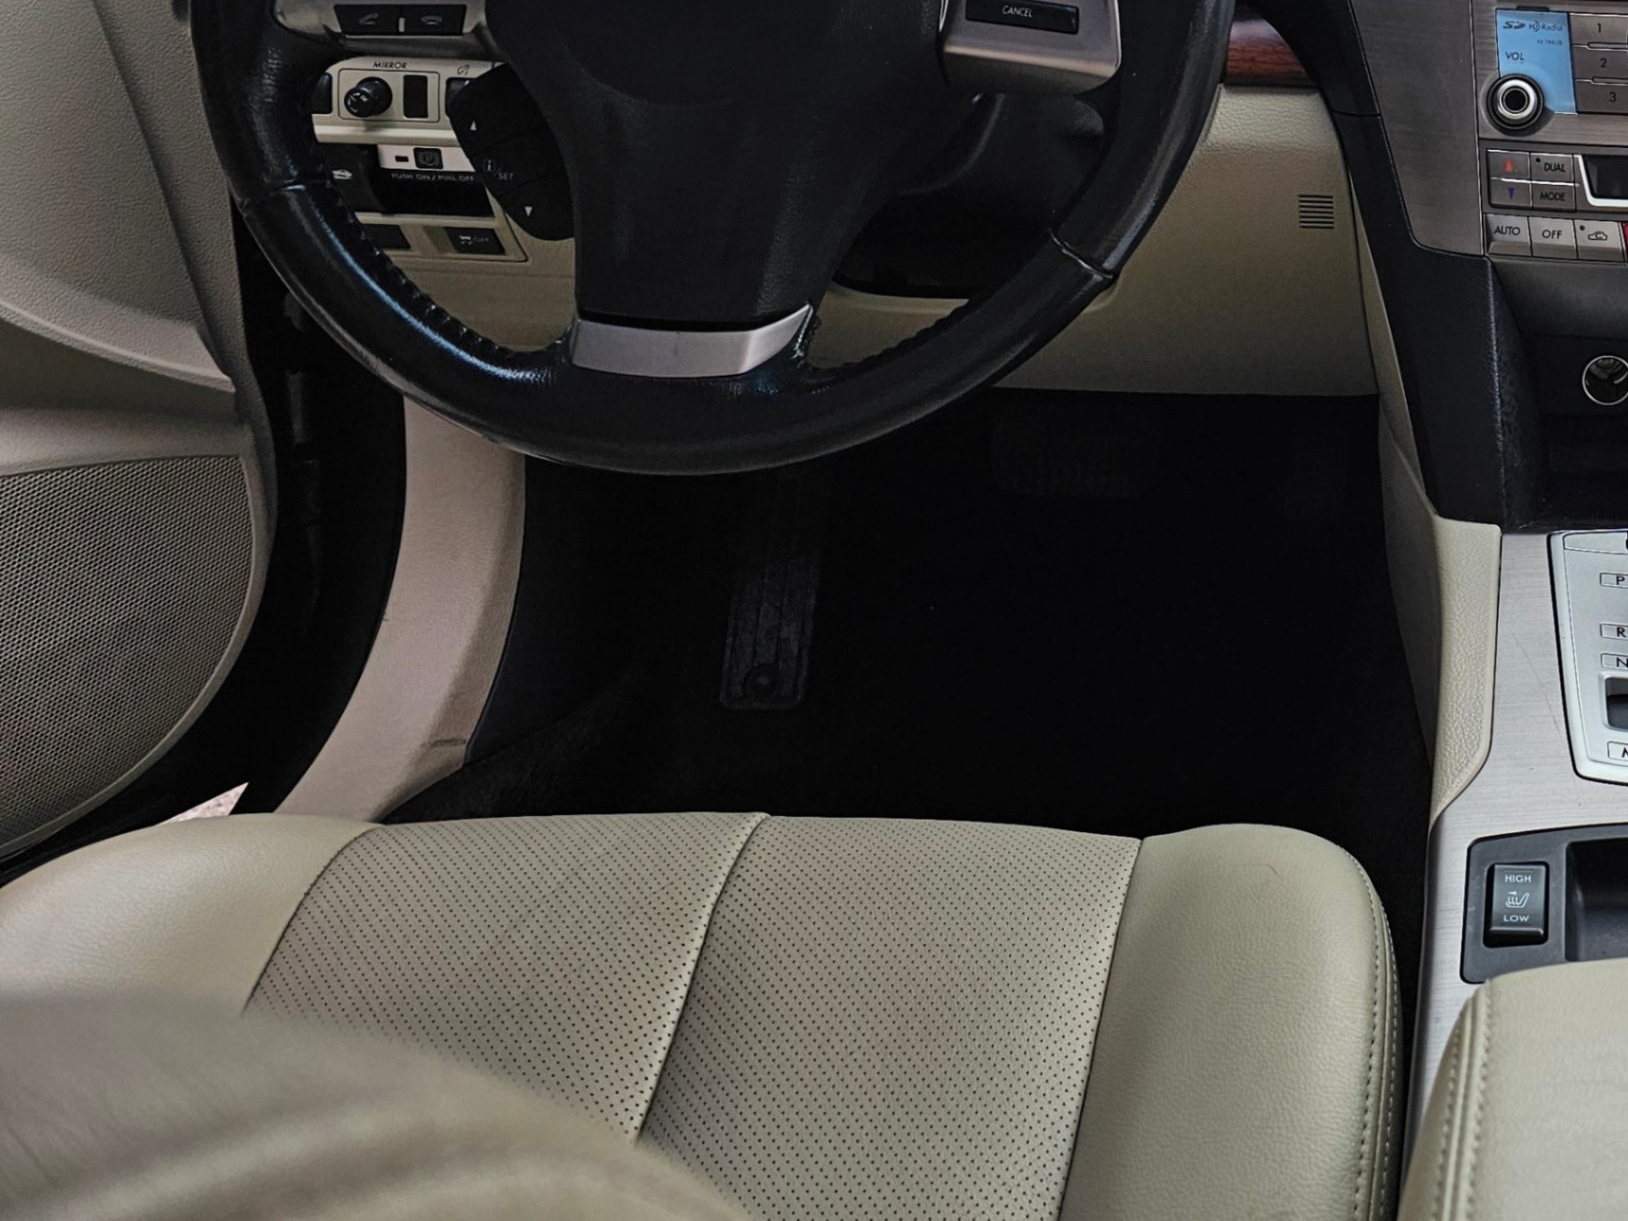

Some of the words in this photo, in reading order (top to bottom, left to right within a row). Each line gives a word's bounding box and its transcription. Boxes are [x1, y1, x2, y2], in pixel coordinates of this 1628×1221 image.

[1001, 4, 1033, 19] CANCEL
[1596, 22, 1603, 34] 1
[1504, 51, 1525, 61] VOL
[373, 61, 408, 70] MIRROR
[1600, 57, 1608, 68] 2
[1608, 91, 1617, 104] 3
[1543, 162, 1566, 172] DUAL
[1539, 192, 1566, 202] MODE
[1493, 225, 1521, 236] AUTO
[1541, 229, 1563, 240] OFF
[1616, 576, 1626, 586] P
[1616, 627, 1627, 638] R
[1504, 873, 1532, 884] HIGH
[1503, 913, 1530, 924] LOW
